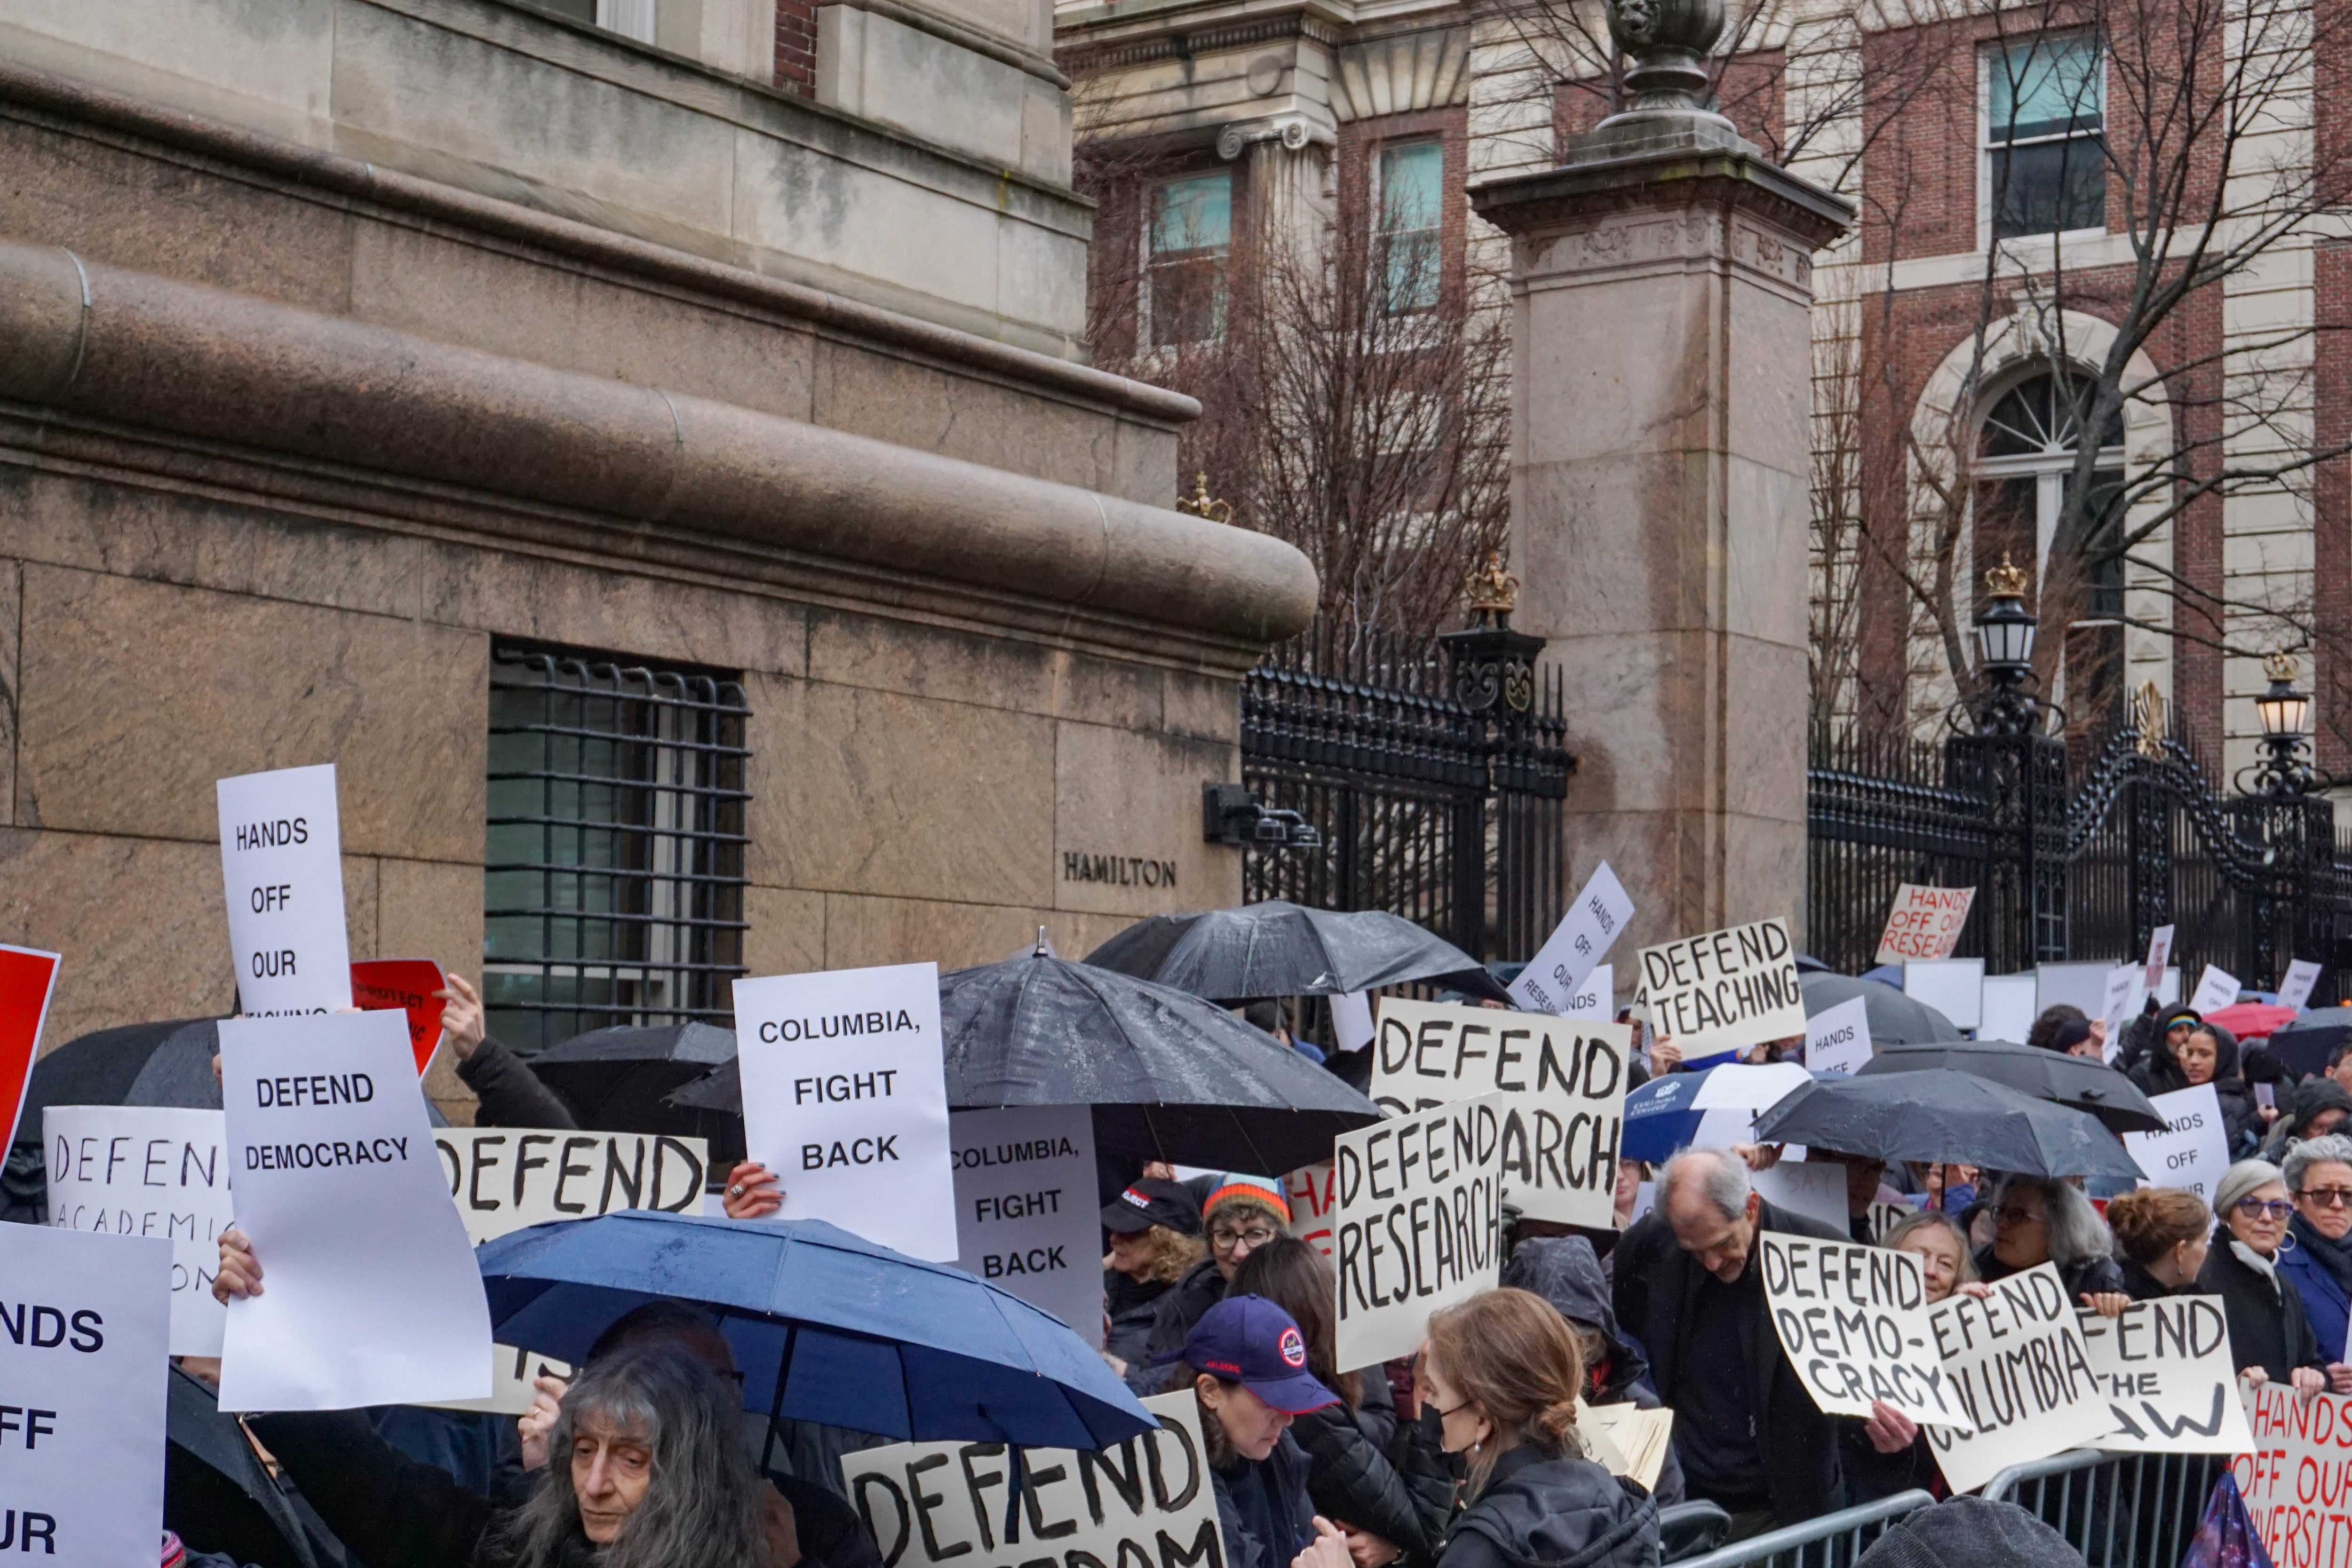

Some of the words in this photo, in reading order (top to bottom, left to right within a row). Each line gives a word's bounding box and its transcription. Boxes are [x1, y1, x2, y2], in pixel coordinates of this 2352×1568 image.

[237, 818, 308, 851] HANDS
[1063, 851, 1176, 887] HAMILTON
[251, 885, 291, 913] OFF
[1588, 895, 1614, 935] HANDS
[1909, 888, 1970, 914] HANDS
[1891, 911, 1934, 931] OFF
[252, 950, 296, 979] OUR
[1574, 934, 1592, 958] OFF
[1645, 922, 1788, 990] DEFEND
[1553, 963, 1573, 991] OUR
[1563, 993, 1597, 1012] NDS
[1654, 964, 1801, 1037] TEACHING
[758, 1009, 921, 1044] COLUMBIA,
[1816, 1026, 1854, 1053] HANDS
[1380, 1017, 1621, 1100] DEFEND
[256, 1073, 373, 1108] DEFEND
[794, 1069, 898, 1105] FIGHT
[55, 1134, 231, 1190] DEFEN
[246, 1137, 407, 1170] DEMOCRACY
[801, 1135, 899, 1171] BACK
[1337, 1104, 1498, 1210] DEFEND
[2167, 1149, 2198, 1170] OFF
[975, 1189, 1061, 1222] FIGHT
[983, 1245, 1066, 1278] BACK
[1338, 1171, 1500, 1321] RESEARCH
[1764, 1240, 1921, 1311] DEFEND
[0, 1300, 104, 1353] NDS
[1776, 1305, 1925, 1360] DEMO-
[1929, 1271, 2062, 1361] EFEND
[2075, 1299, 2225, 1361] FEND
[1808, 1359, 1949, 1415] CRACY
[0, 1405, 56, 1449] FF
[2095, 1382, 2225, 1441] AW
[2253, 1388, 2352, 1448] HANDS
[852, 1413, 1201, 1568] DEFEND
[2232, 1449, 2286, 1500] OFF
